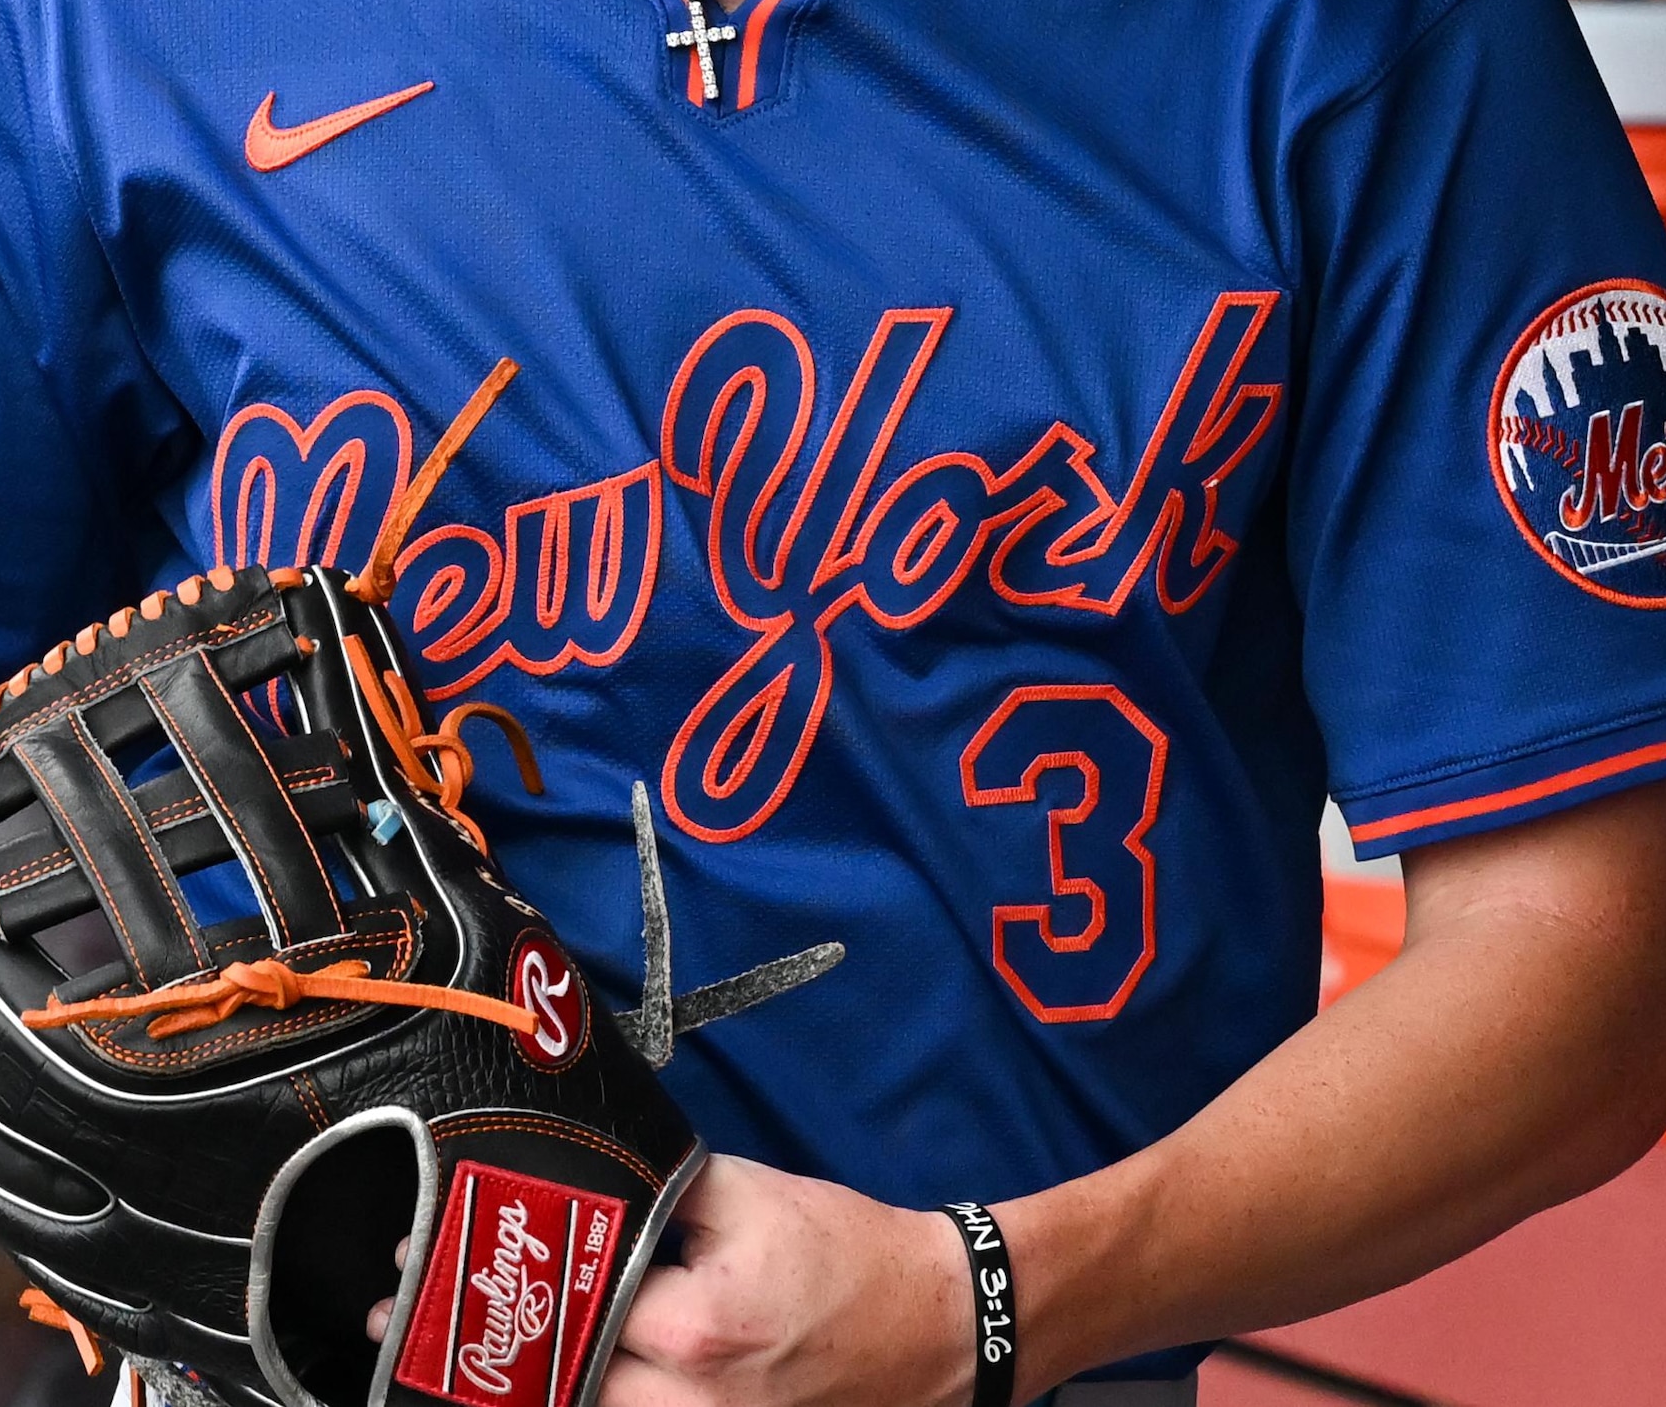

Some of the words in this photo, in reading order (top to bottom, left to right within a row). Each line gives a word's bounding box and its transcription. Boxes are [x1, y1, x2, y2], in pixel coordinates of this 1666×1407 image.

[212, 389, 663, 704] New
[661, 291, 1284, 844] York
[960, 683, 1170, 1024] 3
[458, 1198, 553, 1395] Rawlings
[574, 1257, 602, 1294] Est.
[584, 1208, 610, 1256] 1887
